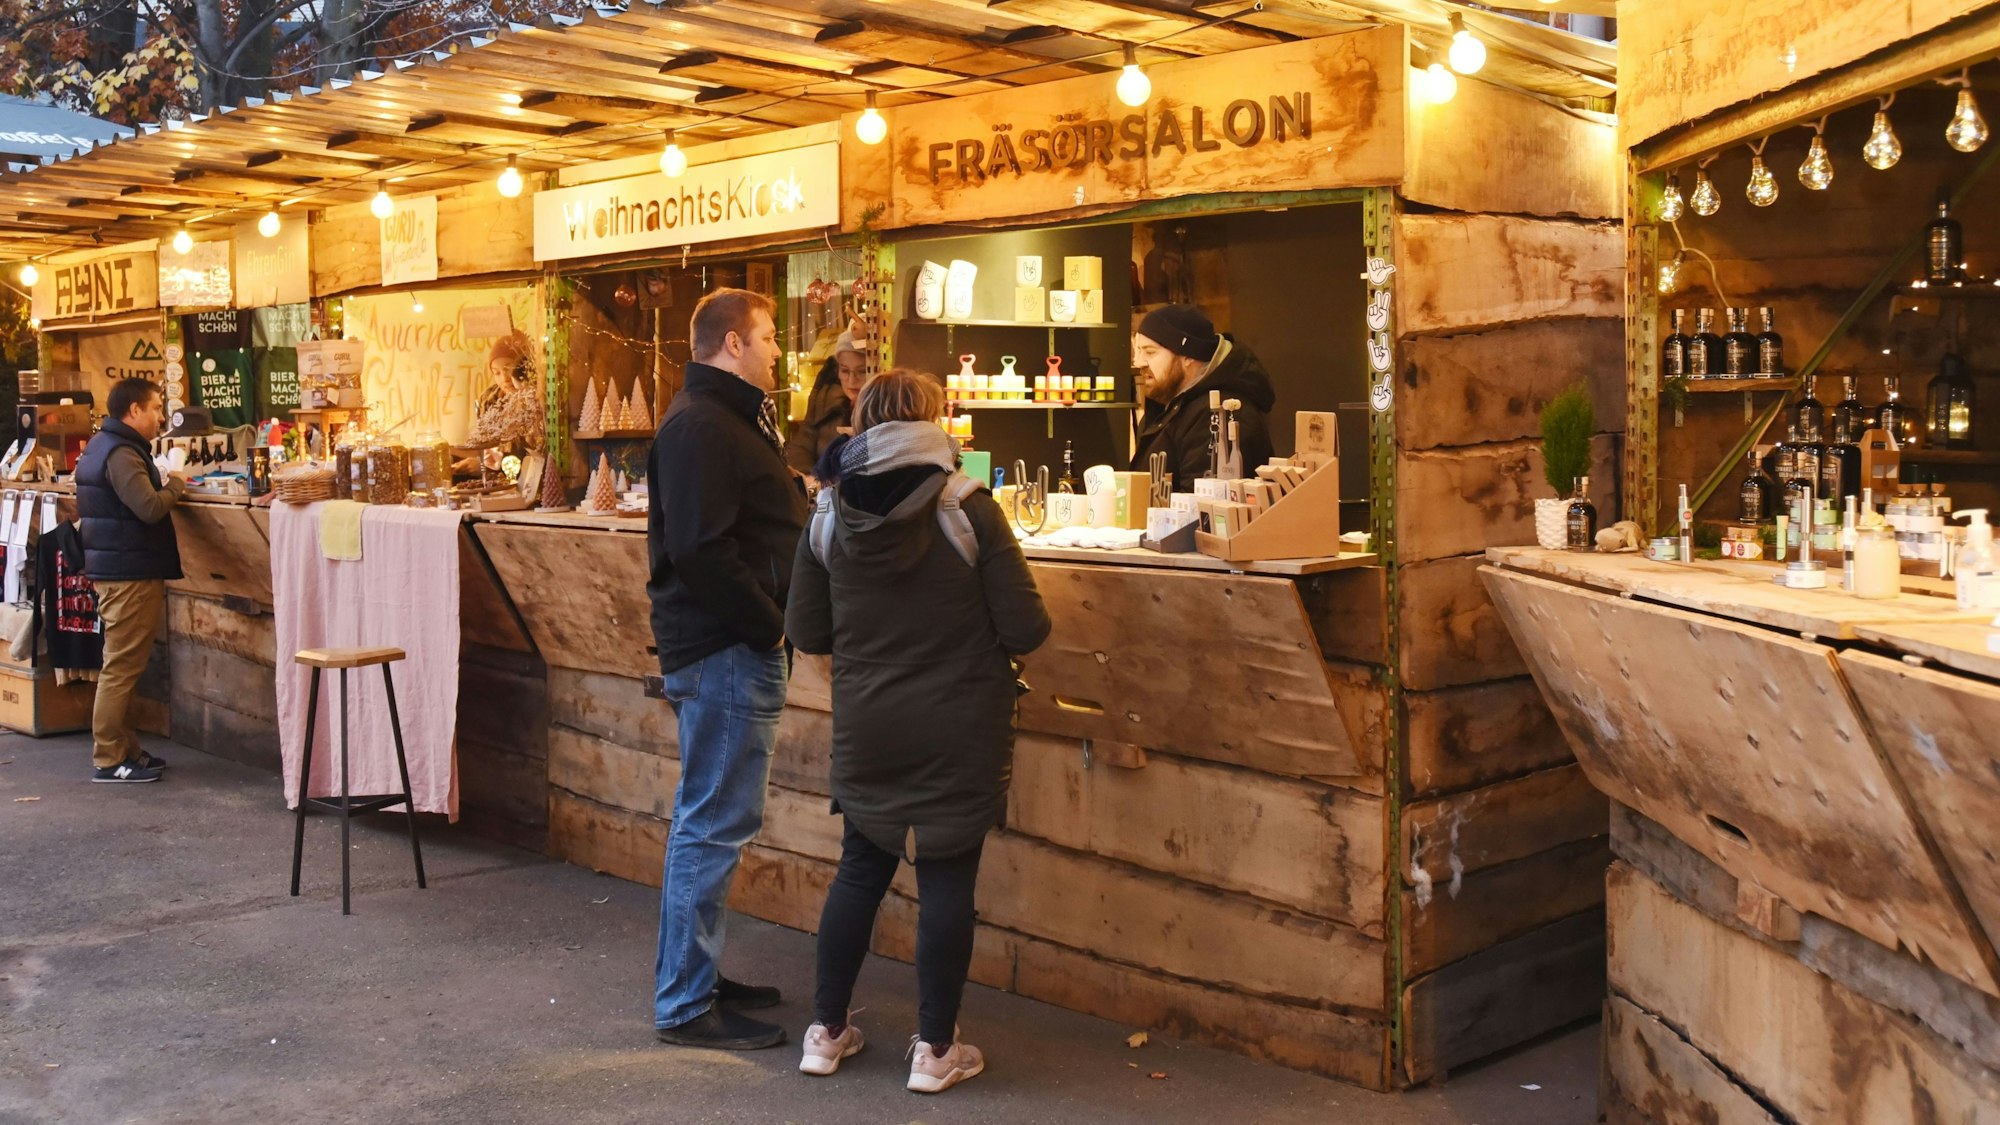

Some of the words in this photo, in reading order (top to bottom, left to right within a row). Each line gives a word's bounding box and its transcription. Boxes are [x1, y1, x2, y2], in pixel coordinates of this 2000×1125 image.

[929, 92, 1311, 185] FRÄSÖRSALON
[55, 258, 133, 315] AYNI
[198, 311, 237, 321] MACHT
[268, 310, 306, 321] MACHT
[198, 321, 237, 333] SCHÖN
[269, 321, 306, 333] SCHÖN
[200, 374, 226, 386] BIER
[270, 371, 296, 382] BIER
[202, 385, 241, 398] MACHT
[270, 383, 301, 393] MACH
[203, 395, 242, 409] SCHÖN
